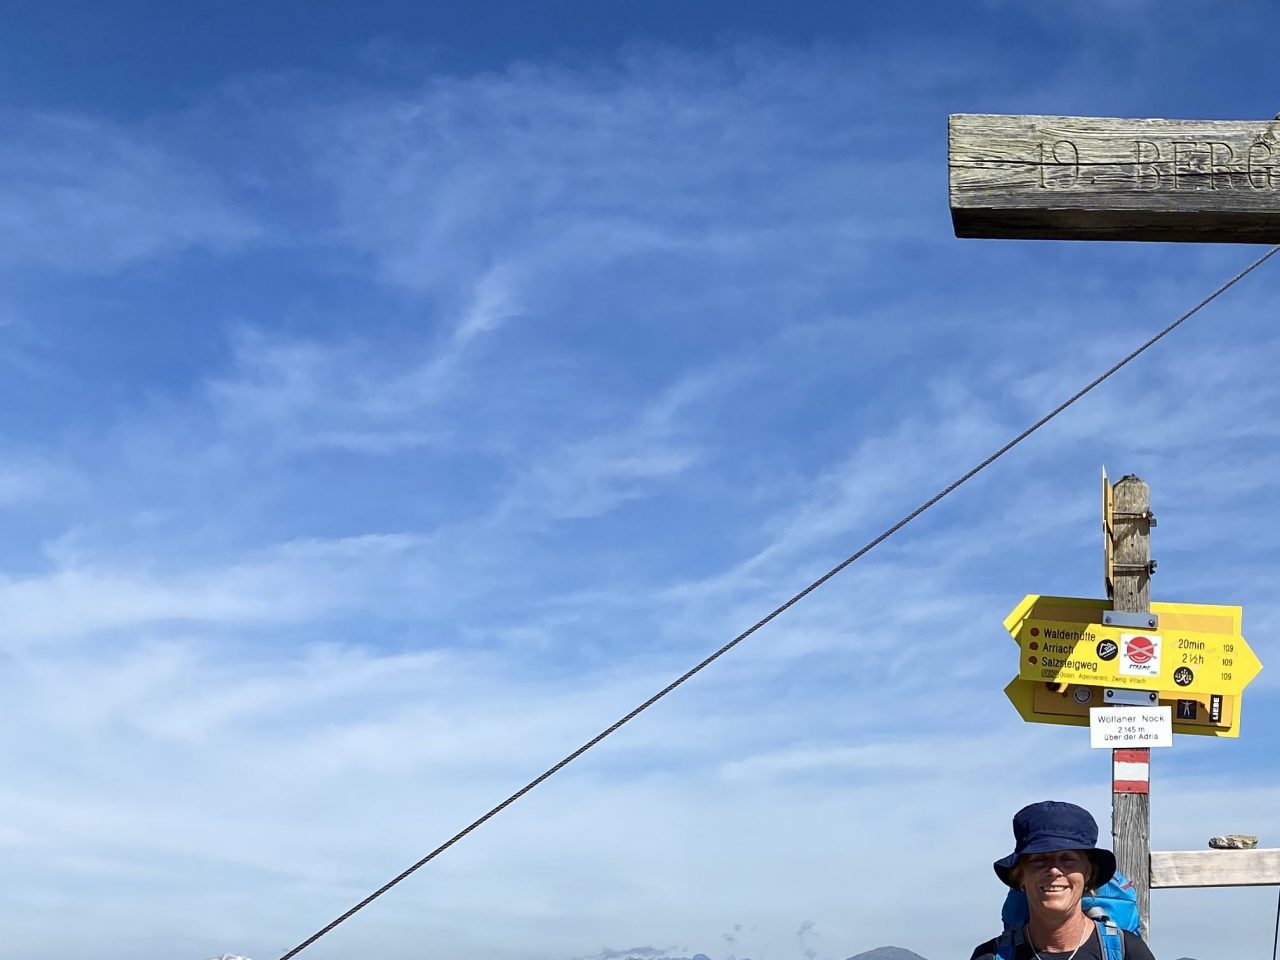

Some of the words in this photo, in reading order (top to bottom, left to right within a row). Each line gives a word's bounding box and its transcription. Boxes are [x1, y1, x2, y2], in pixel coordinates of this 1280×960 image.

[1133, 139, 1276, 192] BERG
[1042, 643, 1074, 654] Arriach
[1222, 658, 1233, 667] 109
[1223, 644, 1234, 653] 109
[1042, 657, 1098, 672] Salzsteigweg
[1221, 672, 1232, 681] 109
[1212, 697, 1220, 720] LIEBE
